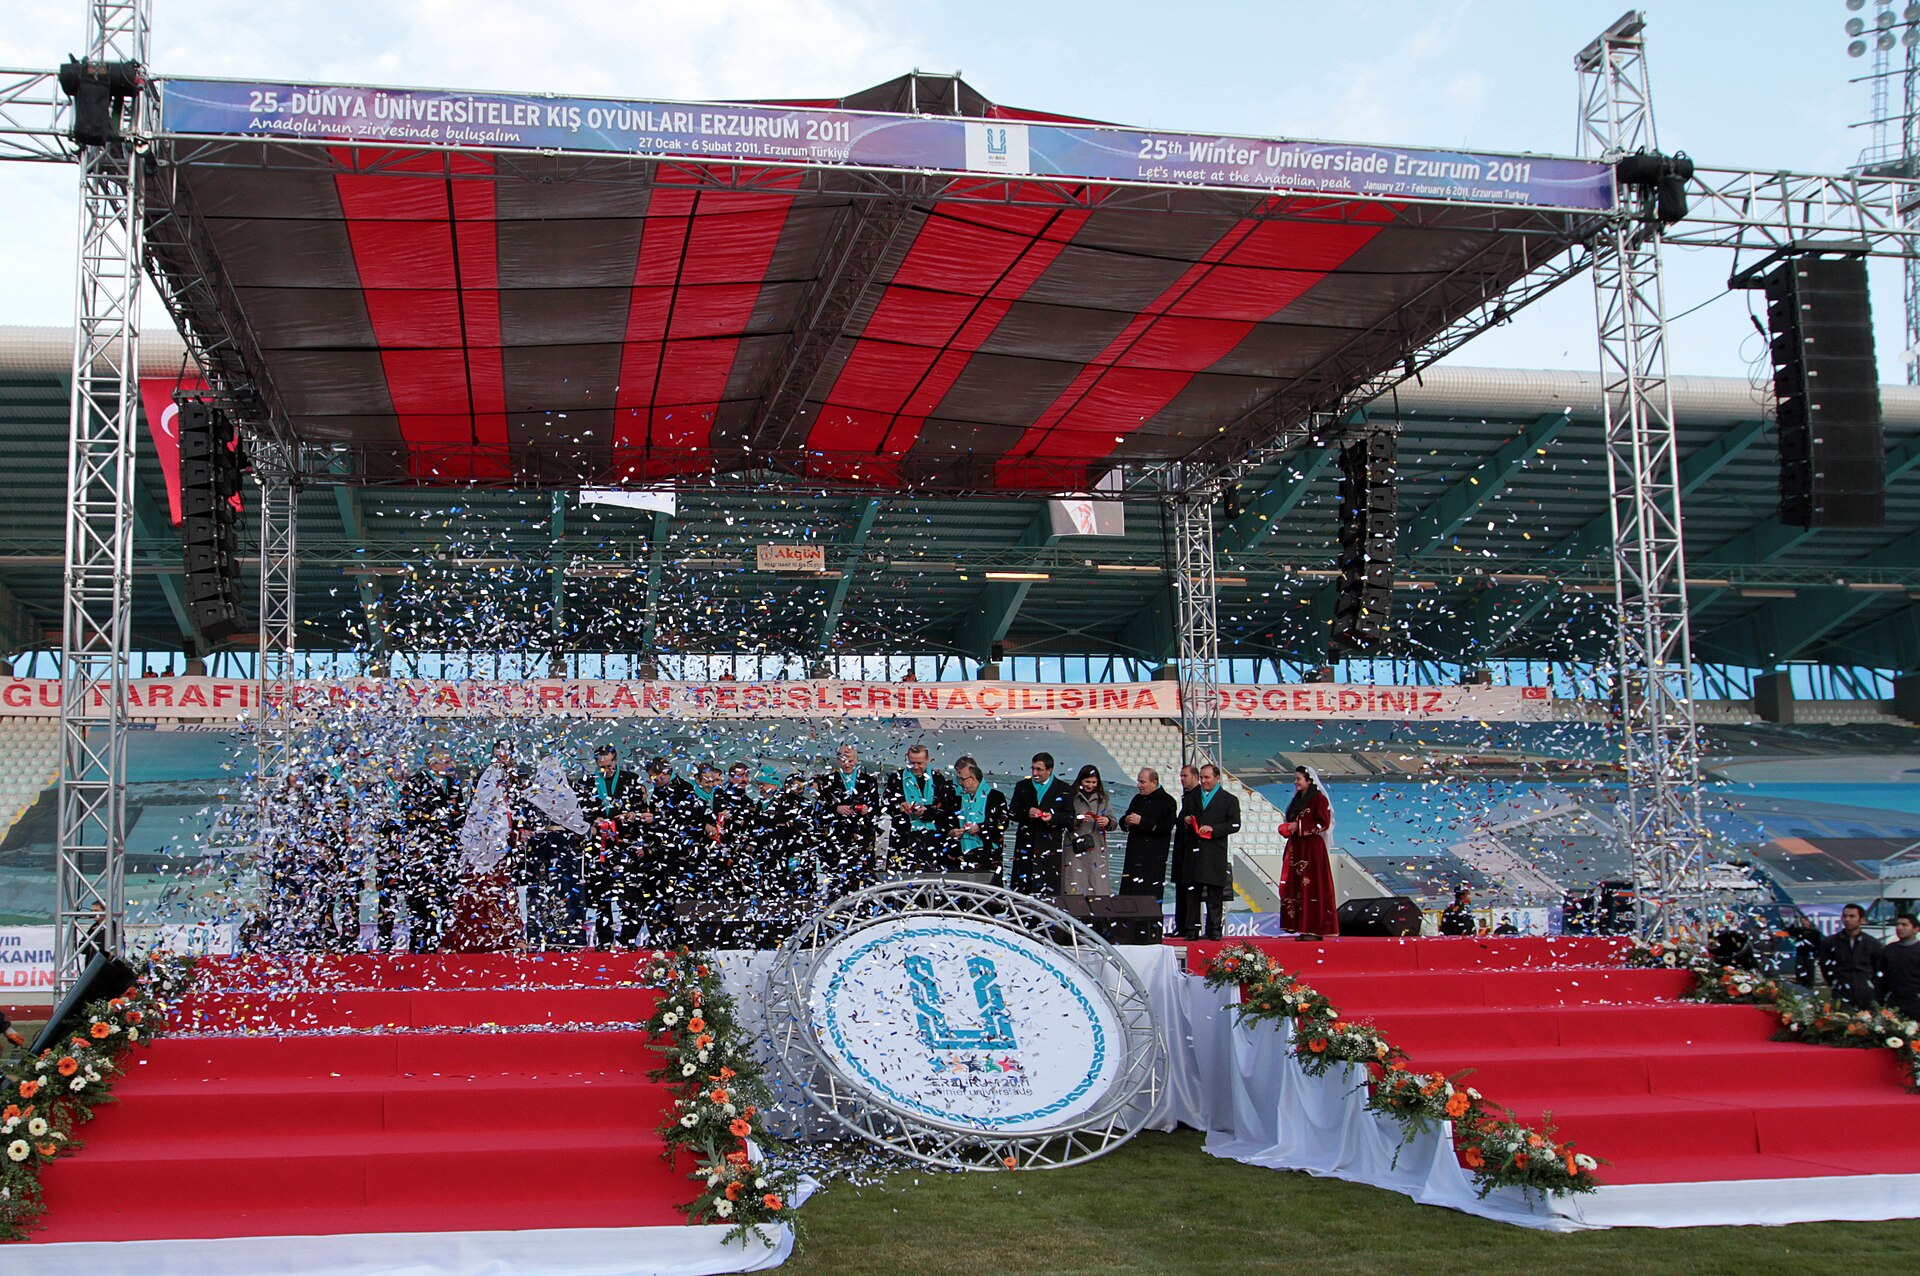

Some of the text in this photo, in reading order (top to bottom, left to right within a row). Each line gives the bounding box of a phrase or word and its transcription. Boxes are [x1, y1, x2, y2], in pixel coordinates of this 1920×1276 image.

[248, 89, 849, 142] 25. DÜNYA ÜNİVERSİTELER KIŞ OYUNLARI ERZURUM 2011
[248, 117, 521, 143] Anadolu'nun zirvesinde buluşalım
[638, 137, 652, 148] 27
[655, 138, 682, 150] Ocak
[692, 140, 699, 150] 6
[702, 140, 732, 153] Şubat
[735, 142, 761, 155] 2011,
[764, 144, 808, 157] Erzurum
[810, 146, 850, 160] Türkiye
[1137, 138, 1531, 183] 25th Winter Universiade Erzurum 2011
[1138, 166, 1351, 191] Let's meet at the Anatolian peak
[1363, 180, 1394, 193] January
[1395, 182, 1405, 192] 27
[1411, 183, 1445, 196] February
[1445, 185, 1451, 195] 6
[1452, 186, 1470, 198] 2011,
[1472, 187, 1503, 199] Erzurum
[1504, 189, 1529, 202] Turkey
[1222, 916, 1260, 937] eak
